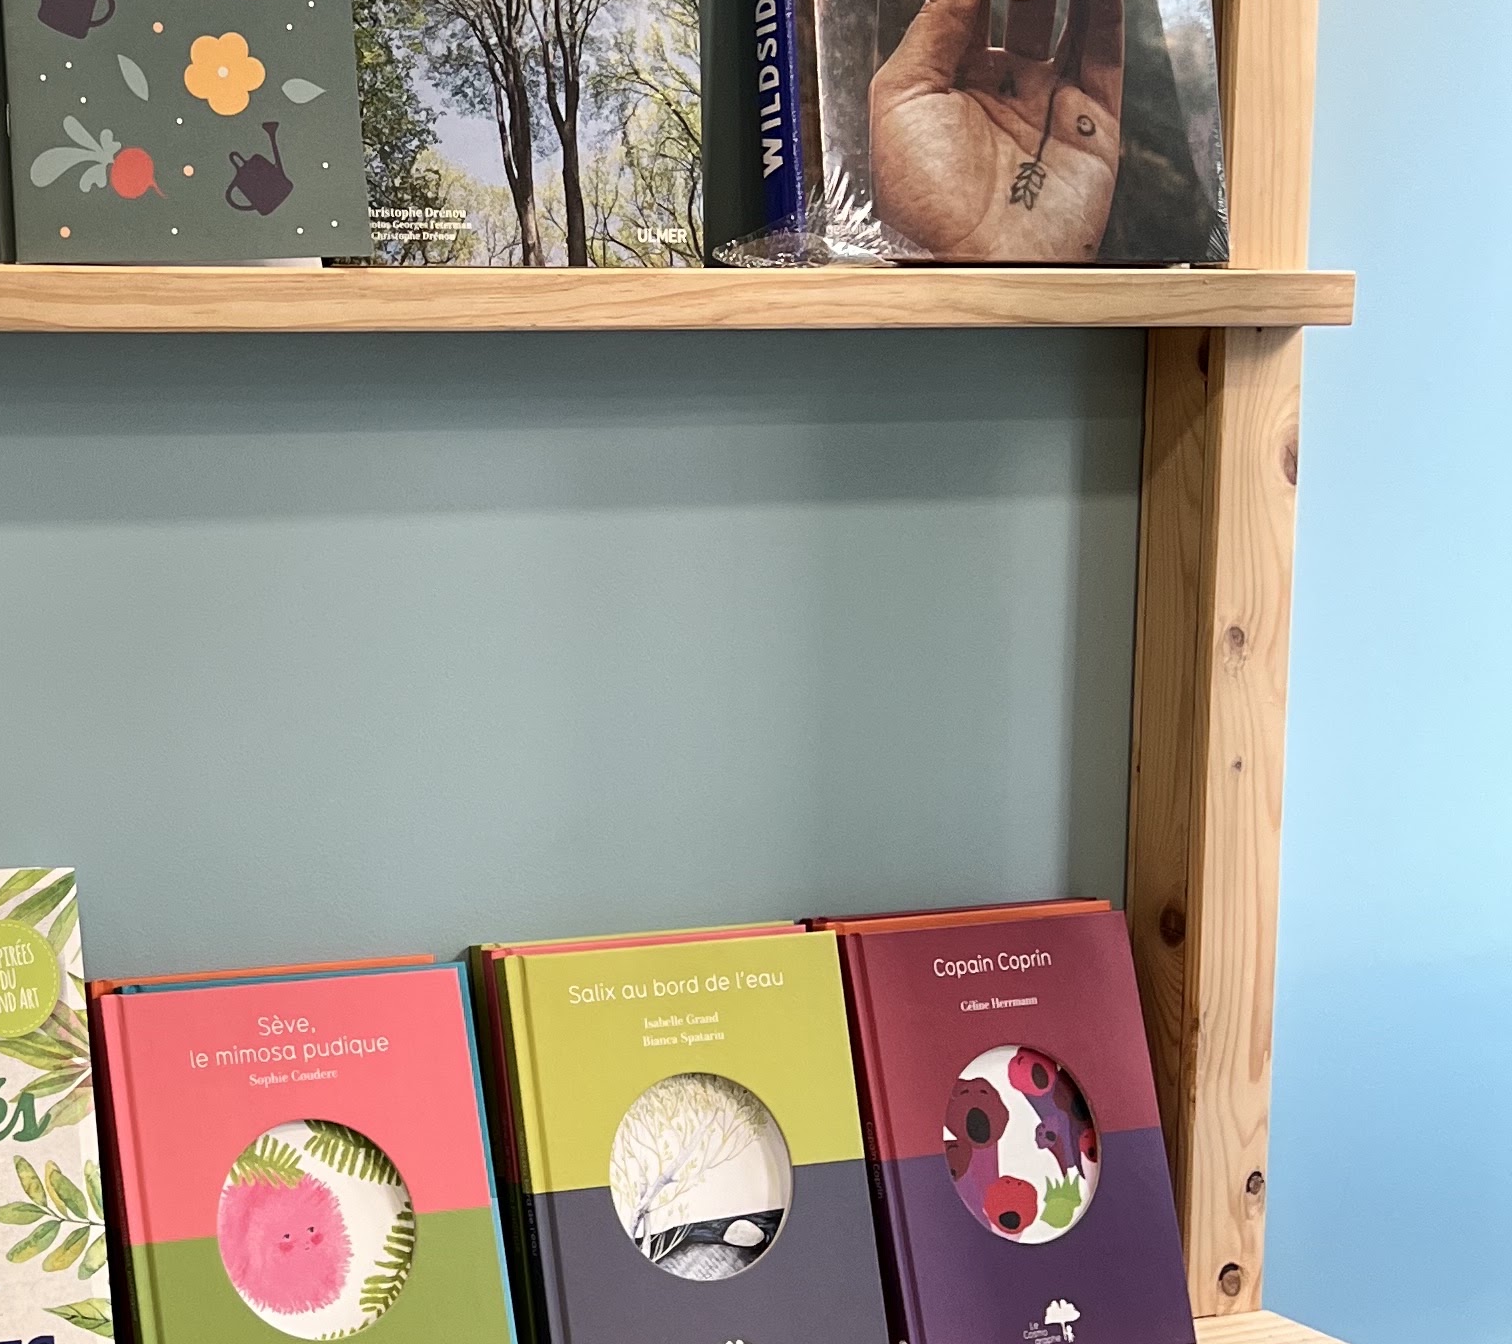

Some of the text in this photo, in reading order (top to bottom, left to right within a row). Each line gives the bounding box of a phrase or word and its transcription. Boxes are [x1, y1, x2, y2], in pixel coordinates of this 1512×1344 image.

[637, 227, 687, 244] ULMER
[933, 948, 1052, 979] Copain Coprin
[0, 968, 17, 991] DU
[568, 971, 784, 1004] Salix au bord de l'eau
[960, 997, 1038, 1013] Céline Herrmann
[257, 1015, 316, 1036] Sève,
[644, 1012, 719, 1029] Isabelle Grand
[643, 1034, 678, 1047] Bianca
[189, 1036, 389, 1069] le mimosa pudique
[249, 1072, 288, 1088] Sophie
